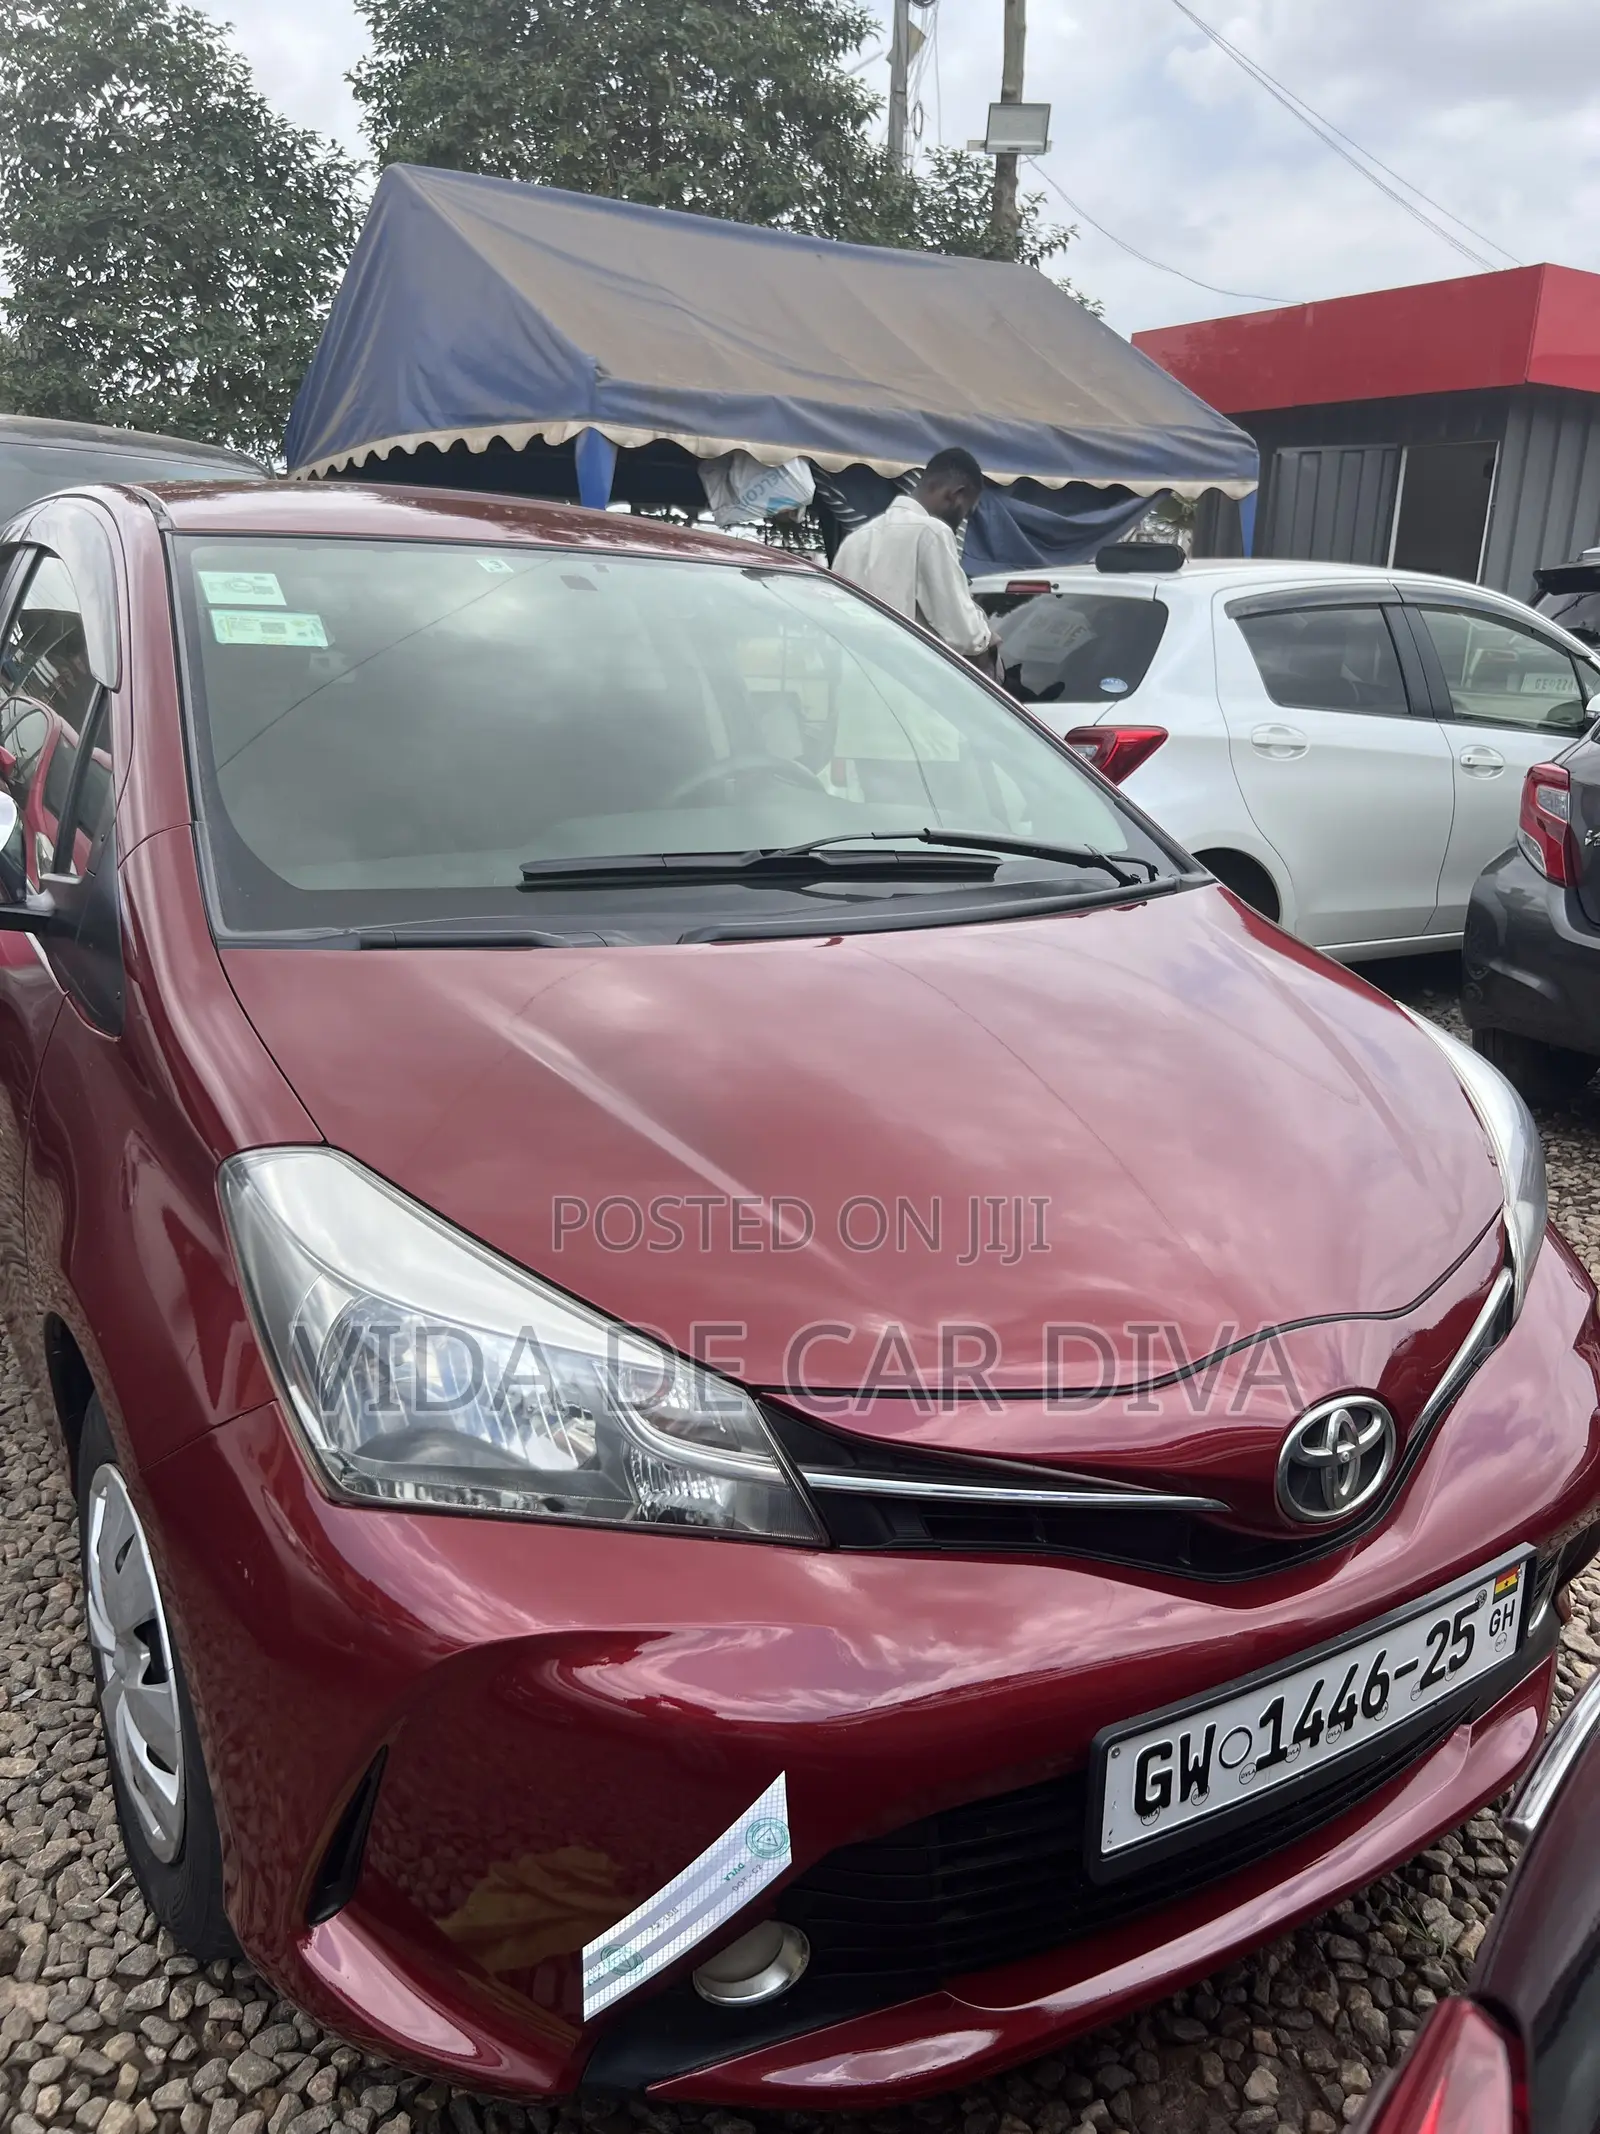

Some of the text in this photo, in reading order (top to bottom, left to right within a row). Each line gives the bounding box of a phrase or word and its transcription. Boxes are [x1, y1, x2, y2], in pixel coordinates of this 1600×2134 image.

[1488, 1598, 1516, 1637] GH
[1255, 1599, 1479, 1772] 1446-25
[723, 1863, 746, 1882] DVLA
